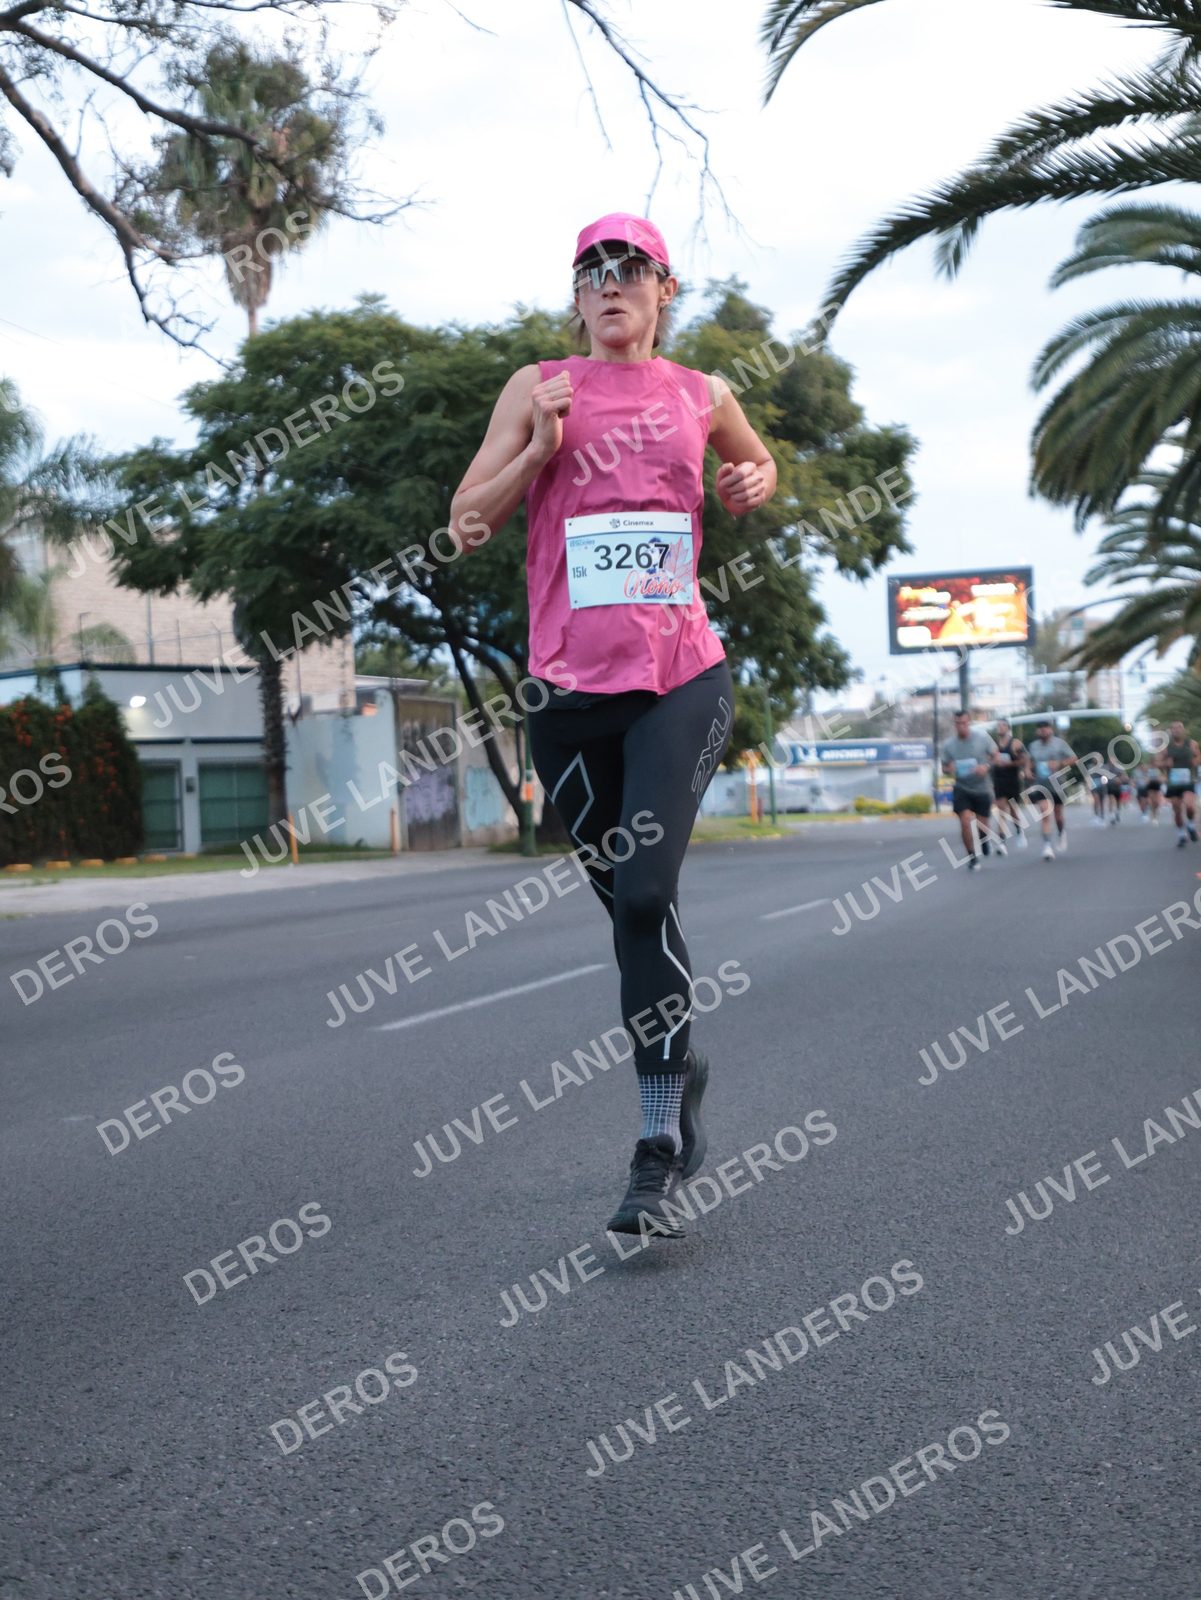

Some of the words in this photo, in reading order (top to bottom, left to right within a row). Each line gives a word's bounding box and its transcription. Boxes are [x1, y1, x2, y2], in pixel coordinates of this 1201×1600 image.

[622, 519, 654, 527] Cinemex
[594, 542, 670, 571] 3267
[572, 565, 588, 579] 15k
